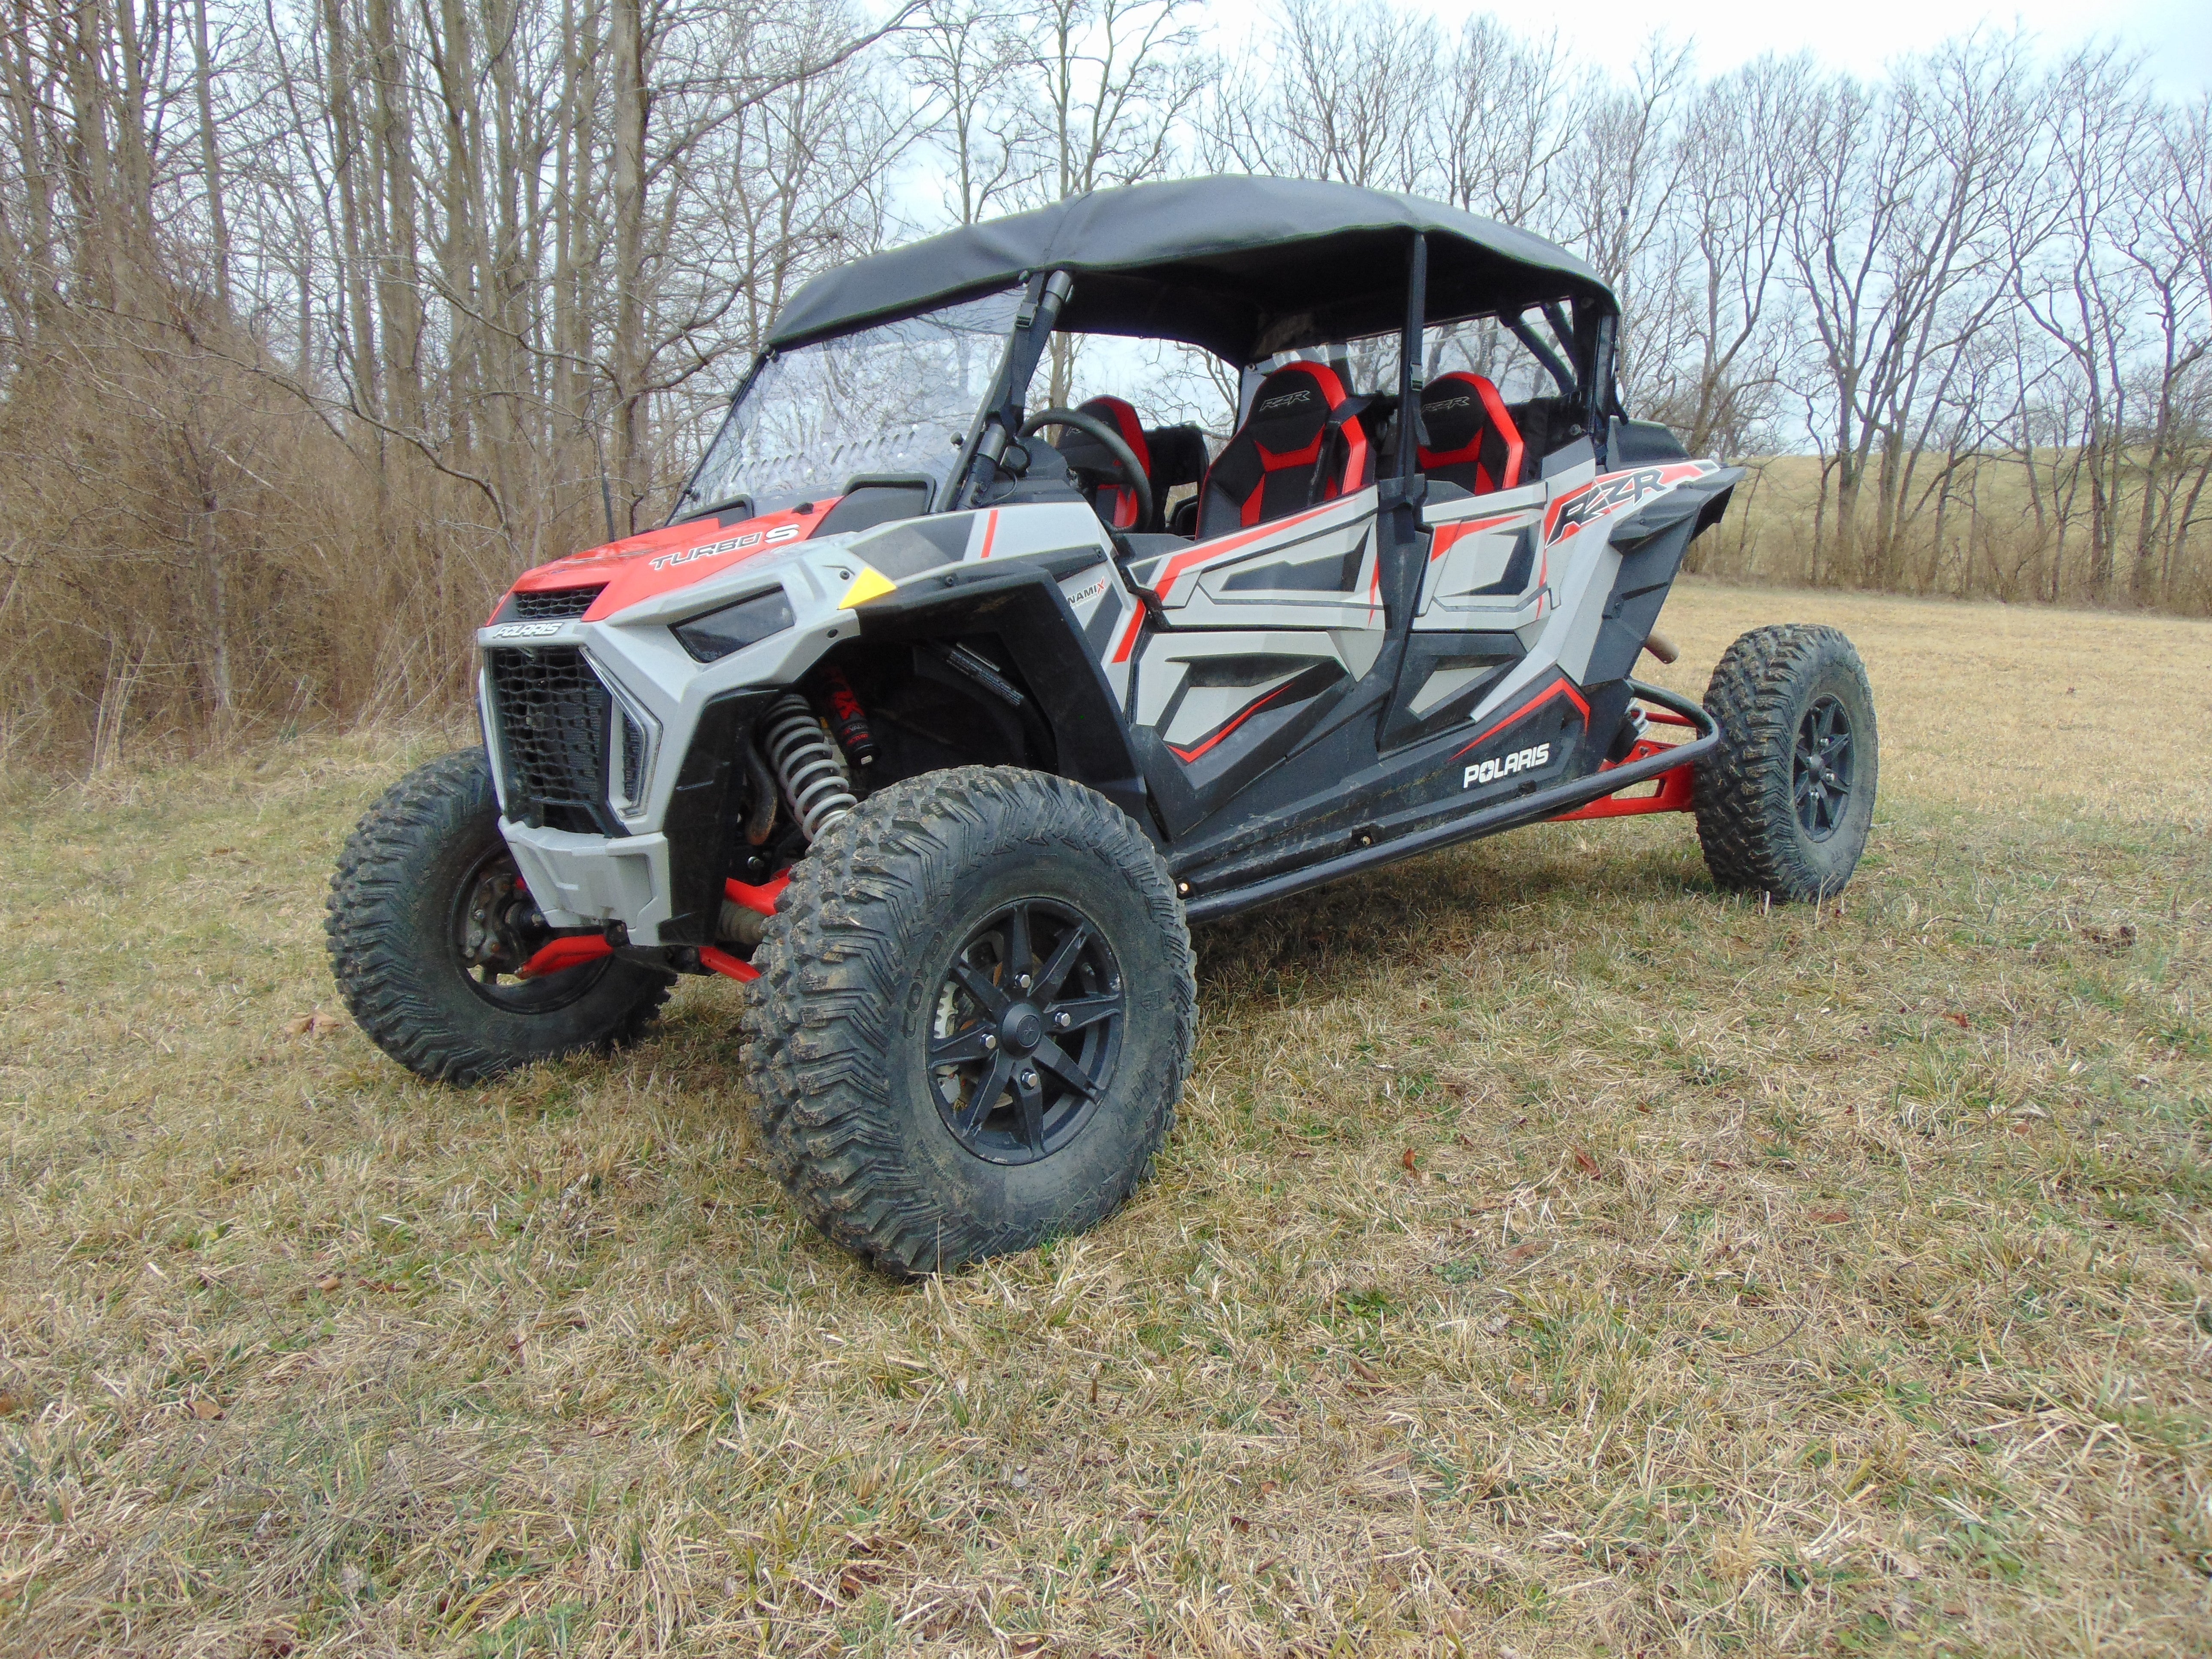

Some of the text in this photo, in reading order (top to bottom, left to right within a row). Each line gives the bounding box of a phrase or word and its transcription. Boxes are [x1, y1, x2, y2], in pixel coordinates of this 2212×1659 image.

[1259, 390, 1311, 411] RZR
[1420, 396, 1470, 413] RZR
[1544, 467, 1668, 549] RZR
[649, 523, 800, 571] TURBO S
[1067, 576, 1106, 605] NAMIX
[492, 622, 564, 638] POLARIS
[1463, 743, 1550, 788] POLARIS
